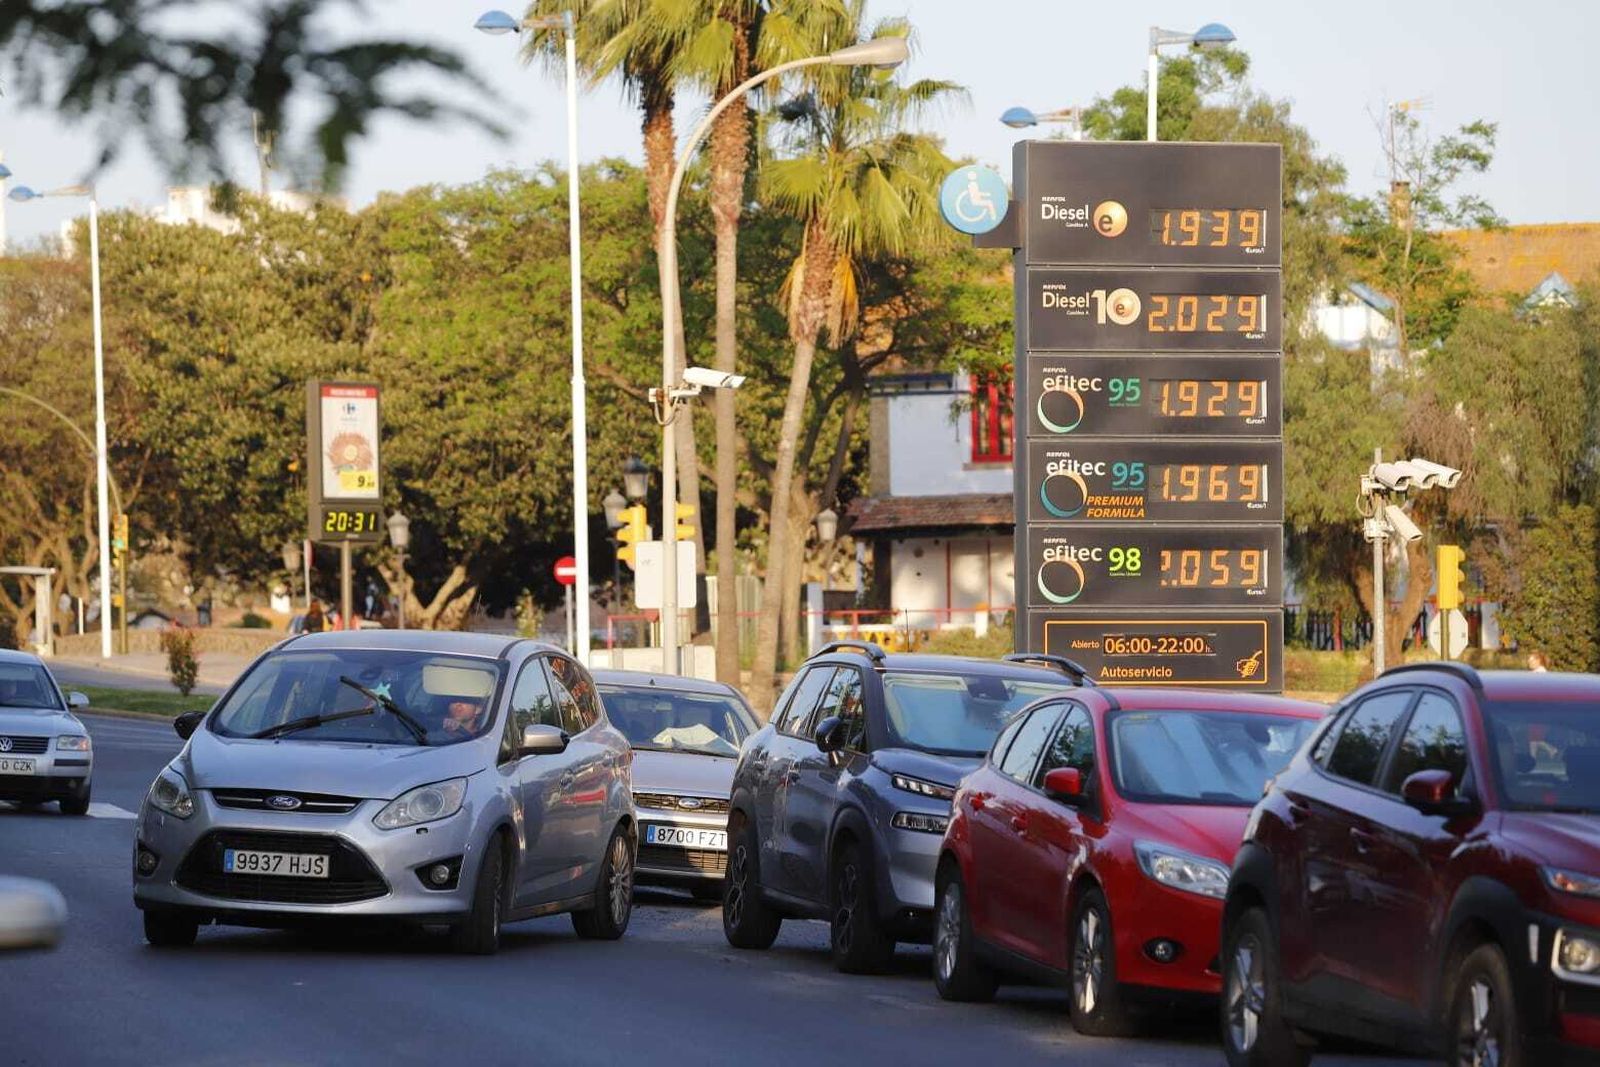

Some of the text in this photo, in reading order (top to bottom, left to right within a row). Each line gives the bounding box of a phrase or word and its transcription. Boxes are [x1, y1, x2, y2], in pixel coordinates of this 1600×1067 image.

[1041, 203, 1113, 233] Diesel e
[1163, 211, 1259, 246] 1.939
[1042, 291, 1090, 308] Diesel
[1148, 295, 1257, 332] 2.029
[1042, 375, 1141, 401] efitec 95
[1162, 380, 1258, 417] 1.929
[1046, 459, 1145, 486] efitec 95
[1162, 465, 1259, 501] 1.969
[1086, 496, 1144, 506] PREMIUM
[1086, 508, 1145, 518] FORMULA
[325, 512, 375, 531] 20:31
[1043, 545, 1141, 571] efitec 98
[1071, 640, 1100, 649] Abierto
[1104, 637, 1204, 653] 06:00-22:00
[1101, 666, 1172, 677] Autoservicio
[658, 829, 694, 844] 8700
[237, 853, 324, 875] 9937 HJS
